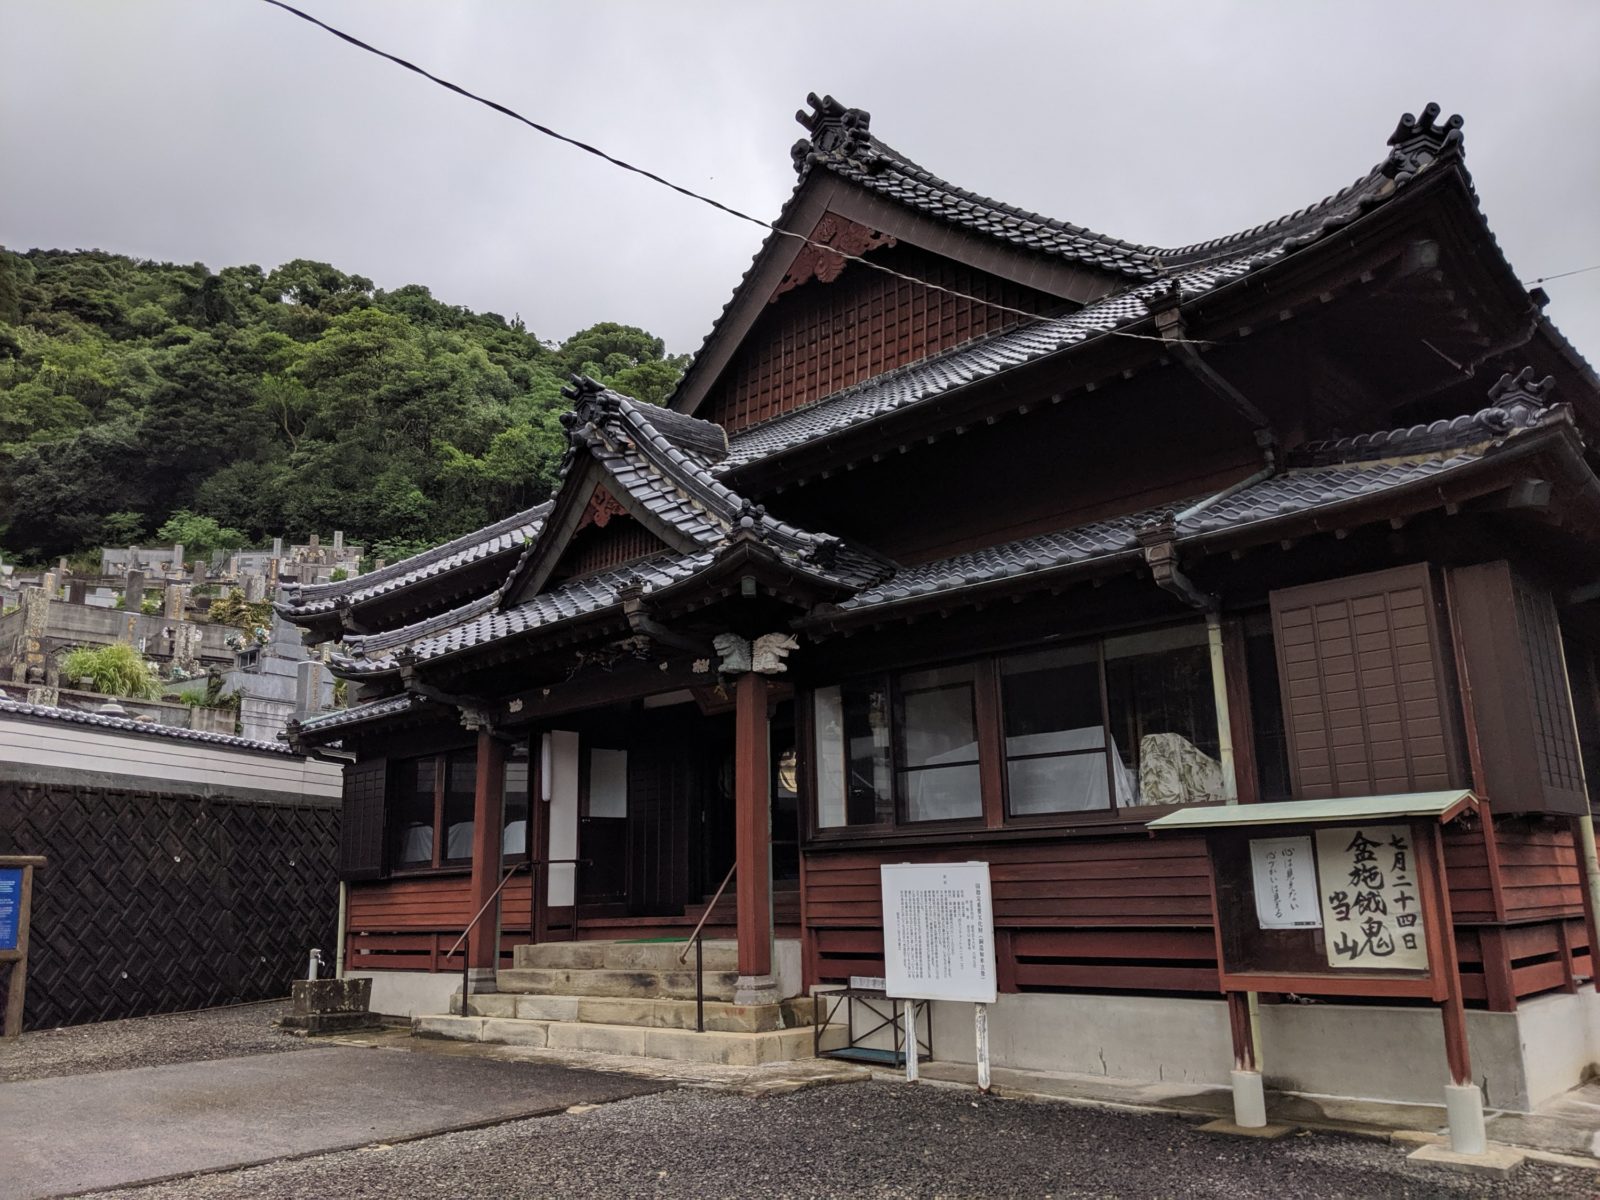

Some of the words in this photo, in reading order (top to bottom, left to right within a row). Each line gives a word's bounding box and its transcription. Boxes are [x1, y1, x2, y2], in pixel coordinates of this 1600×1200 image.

[1328, 891, 1359, 960] 当山
[1345, 830, 1396, 957] 盆施餓鬼
[1388, 834, 1418, 950] 七月二十四日
